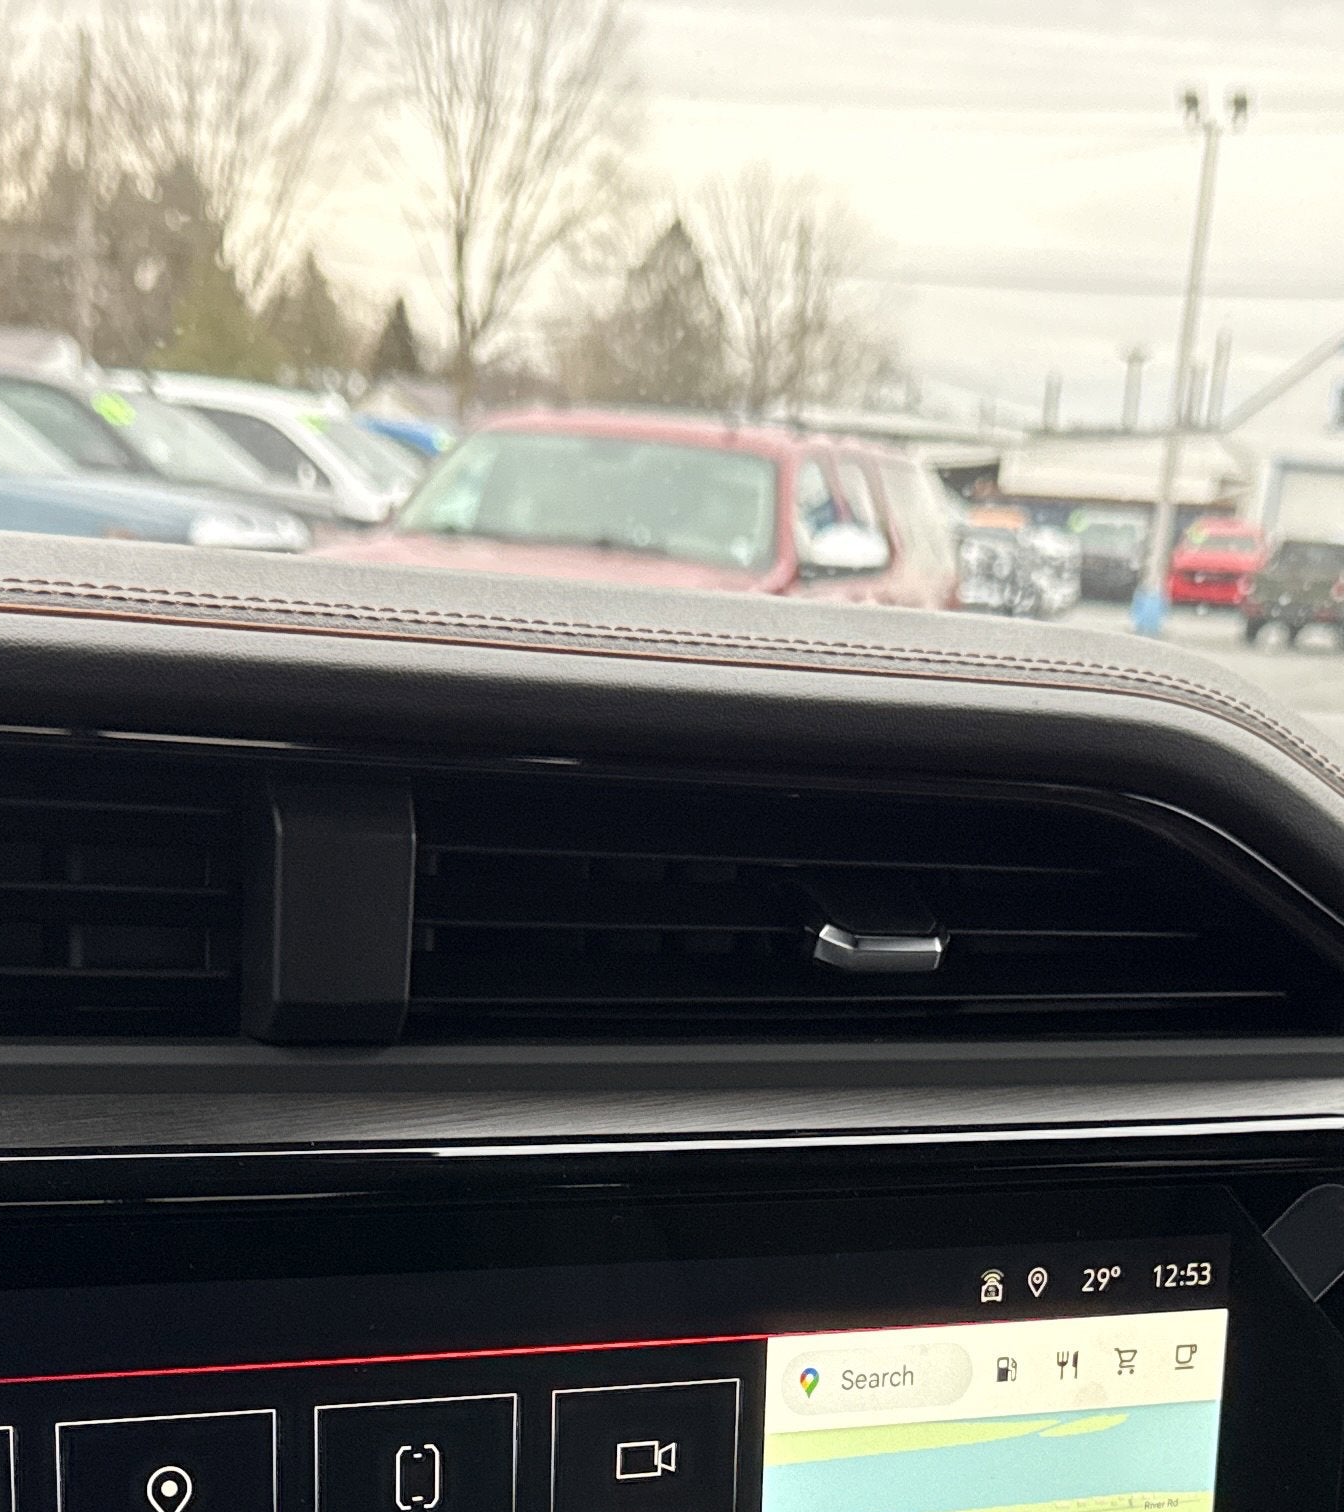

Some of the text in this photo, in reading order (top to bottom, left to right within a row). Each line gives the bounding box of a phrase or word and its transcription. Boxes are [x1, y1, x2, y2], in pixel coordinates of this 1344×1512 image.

[1153, 1261, 1212, 1288] 12:53
[841, 1364, 915, 1391] Search
[1144, 1498, 1179, 1511] River Rd
